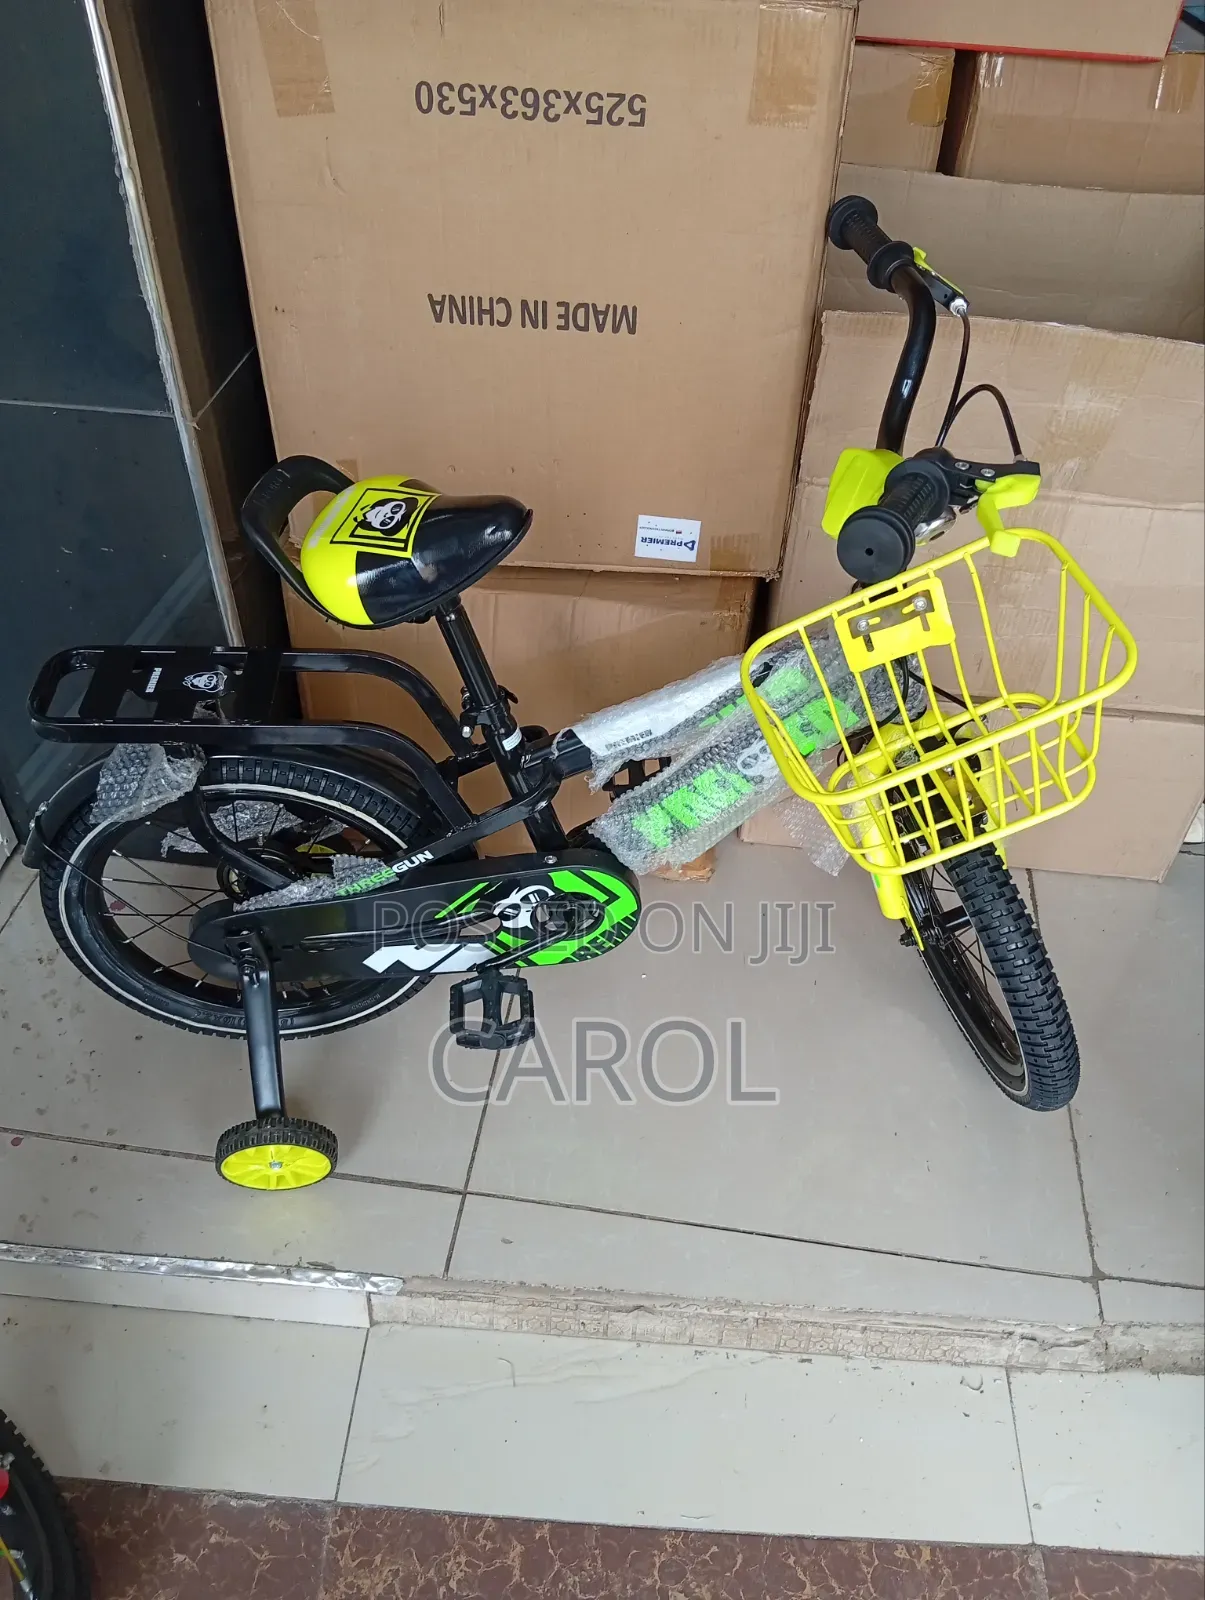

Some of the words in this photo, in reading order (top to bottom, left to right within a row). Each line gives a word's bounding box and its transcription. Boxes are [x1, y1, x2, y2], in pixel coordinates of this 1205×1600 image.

[414, 80, 648, 128] 525x363x530
[427, 293, 513, 328] CHINA
[520, 299, 548, 330] IN
[556, 300, 638, 335] MADE
[640, 536, 683, 547] PREMIER
